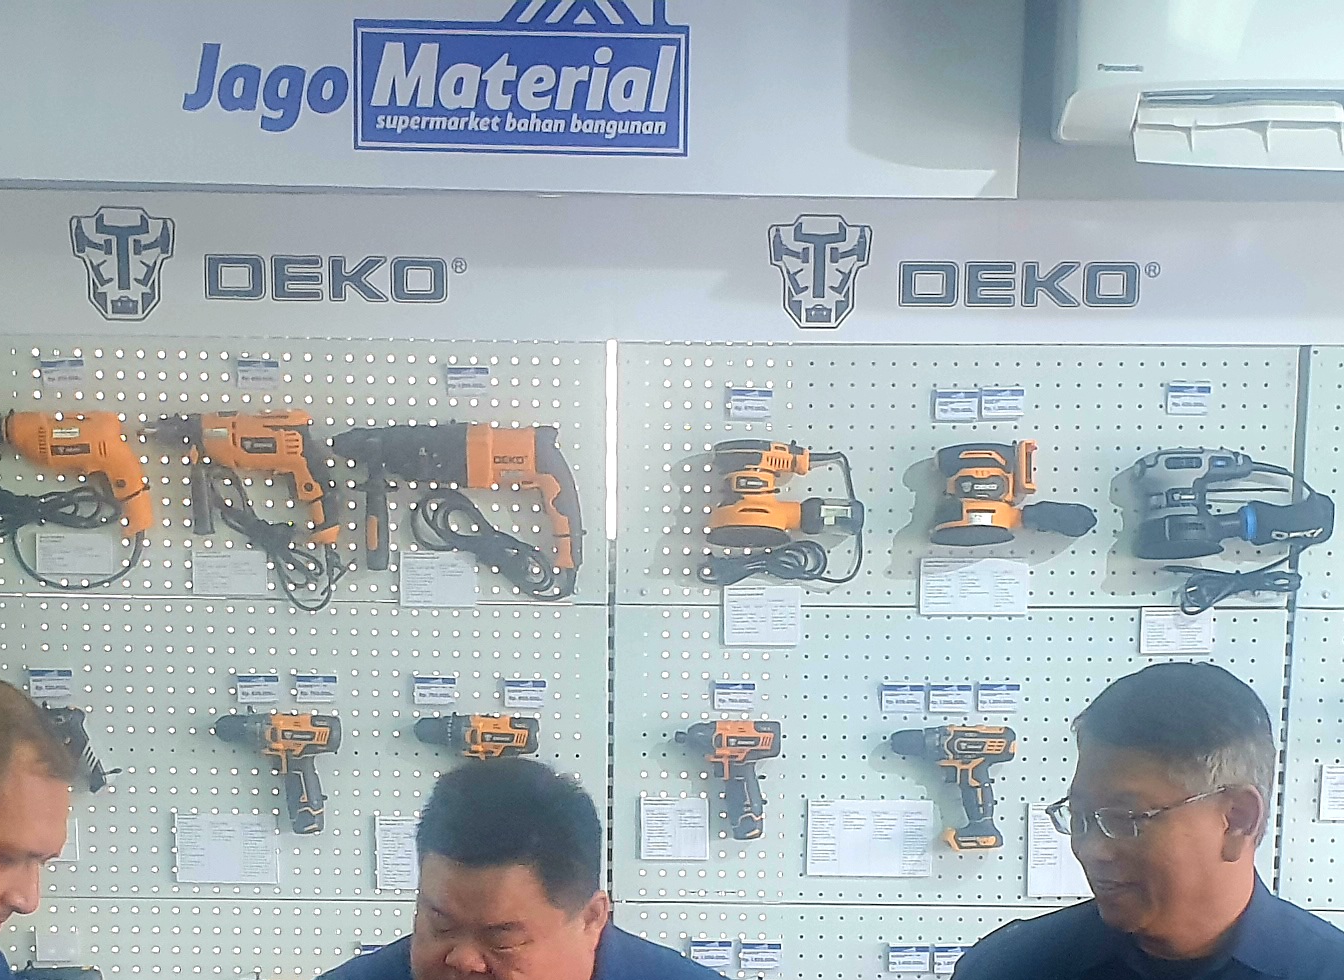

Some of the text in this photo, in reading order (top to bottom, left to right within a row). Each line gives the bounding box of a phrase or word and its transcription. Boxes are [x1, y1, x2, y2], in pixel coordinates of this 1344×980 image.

[184, 42, 677, 133] Jago Material
[375, 112, 667, 139] supermarket bahan bangunan
